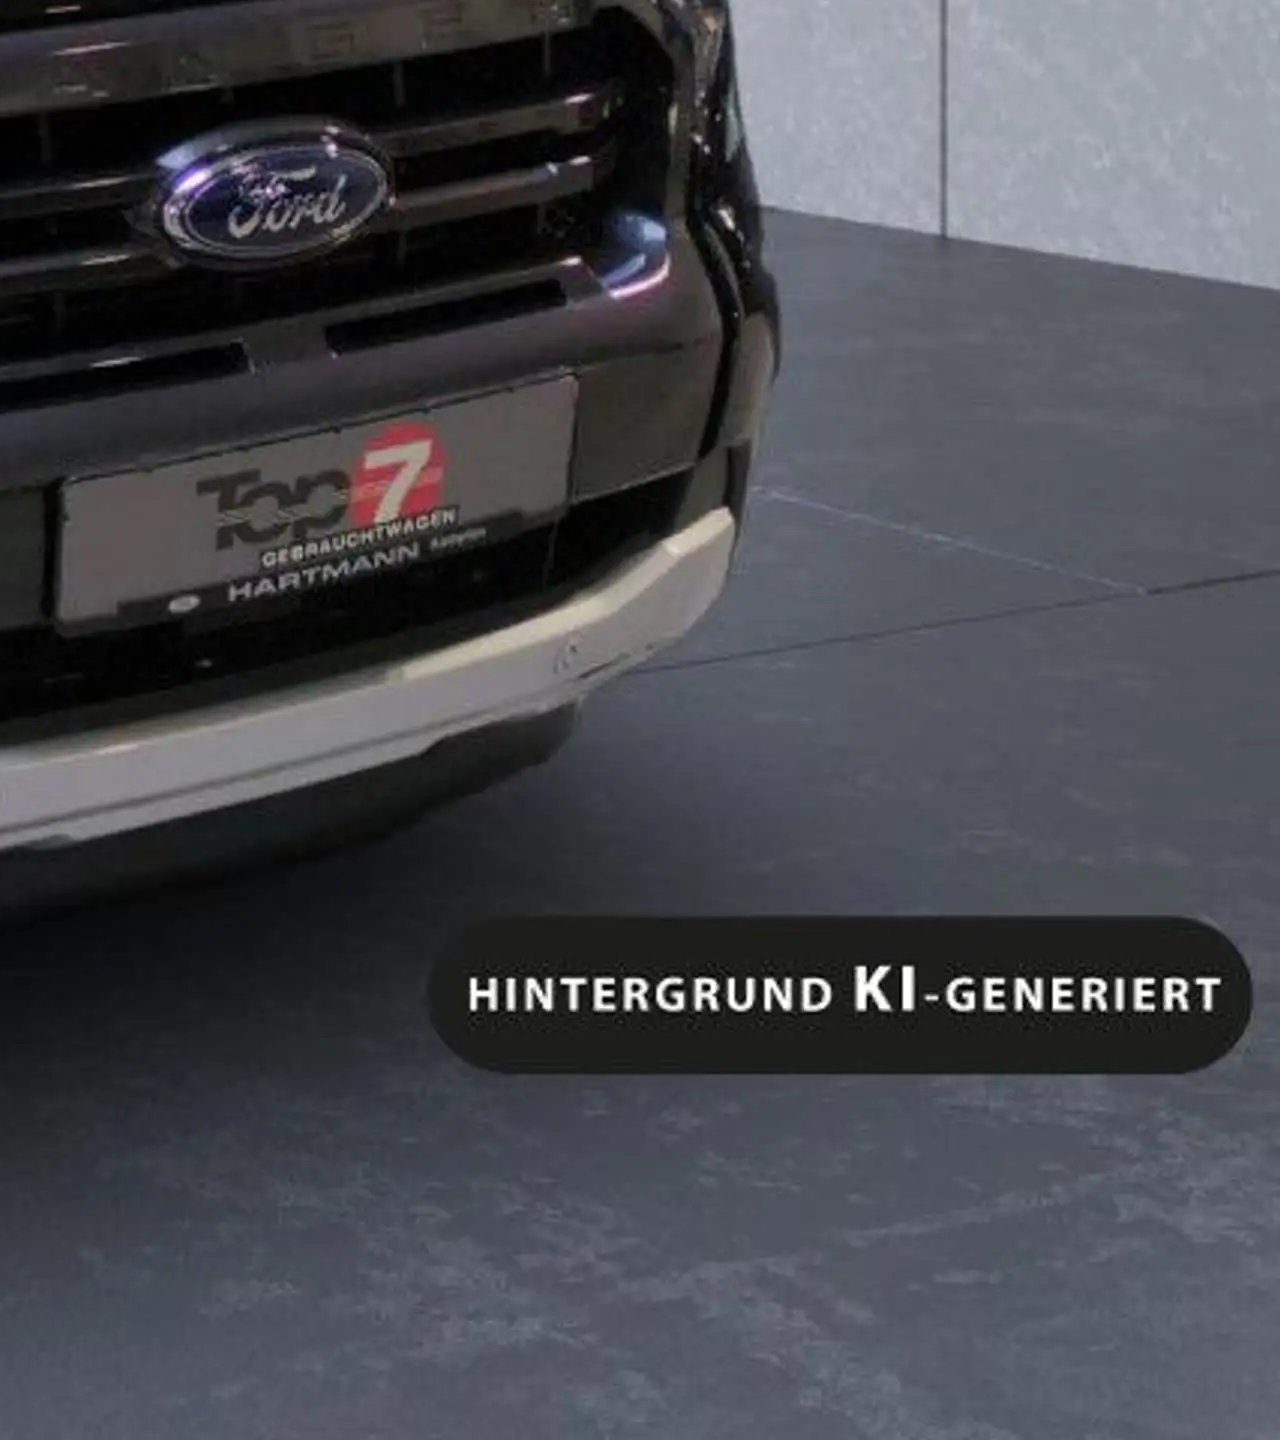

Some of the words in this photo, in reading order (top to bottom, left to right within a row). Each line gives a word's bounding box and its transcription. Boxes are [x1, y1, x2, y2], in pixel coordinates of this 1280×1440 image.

[228, 163, 347, 239] Ford
[261, 507, 458, 567] GEBRAUCHTWAGEN
[227, 541, 420, 603] HARTMANN
